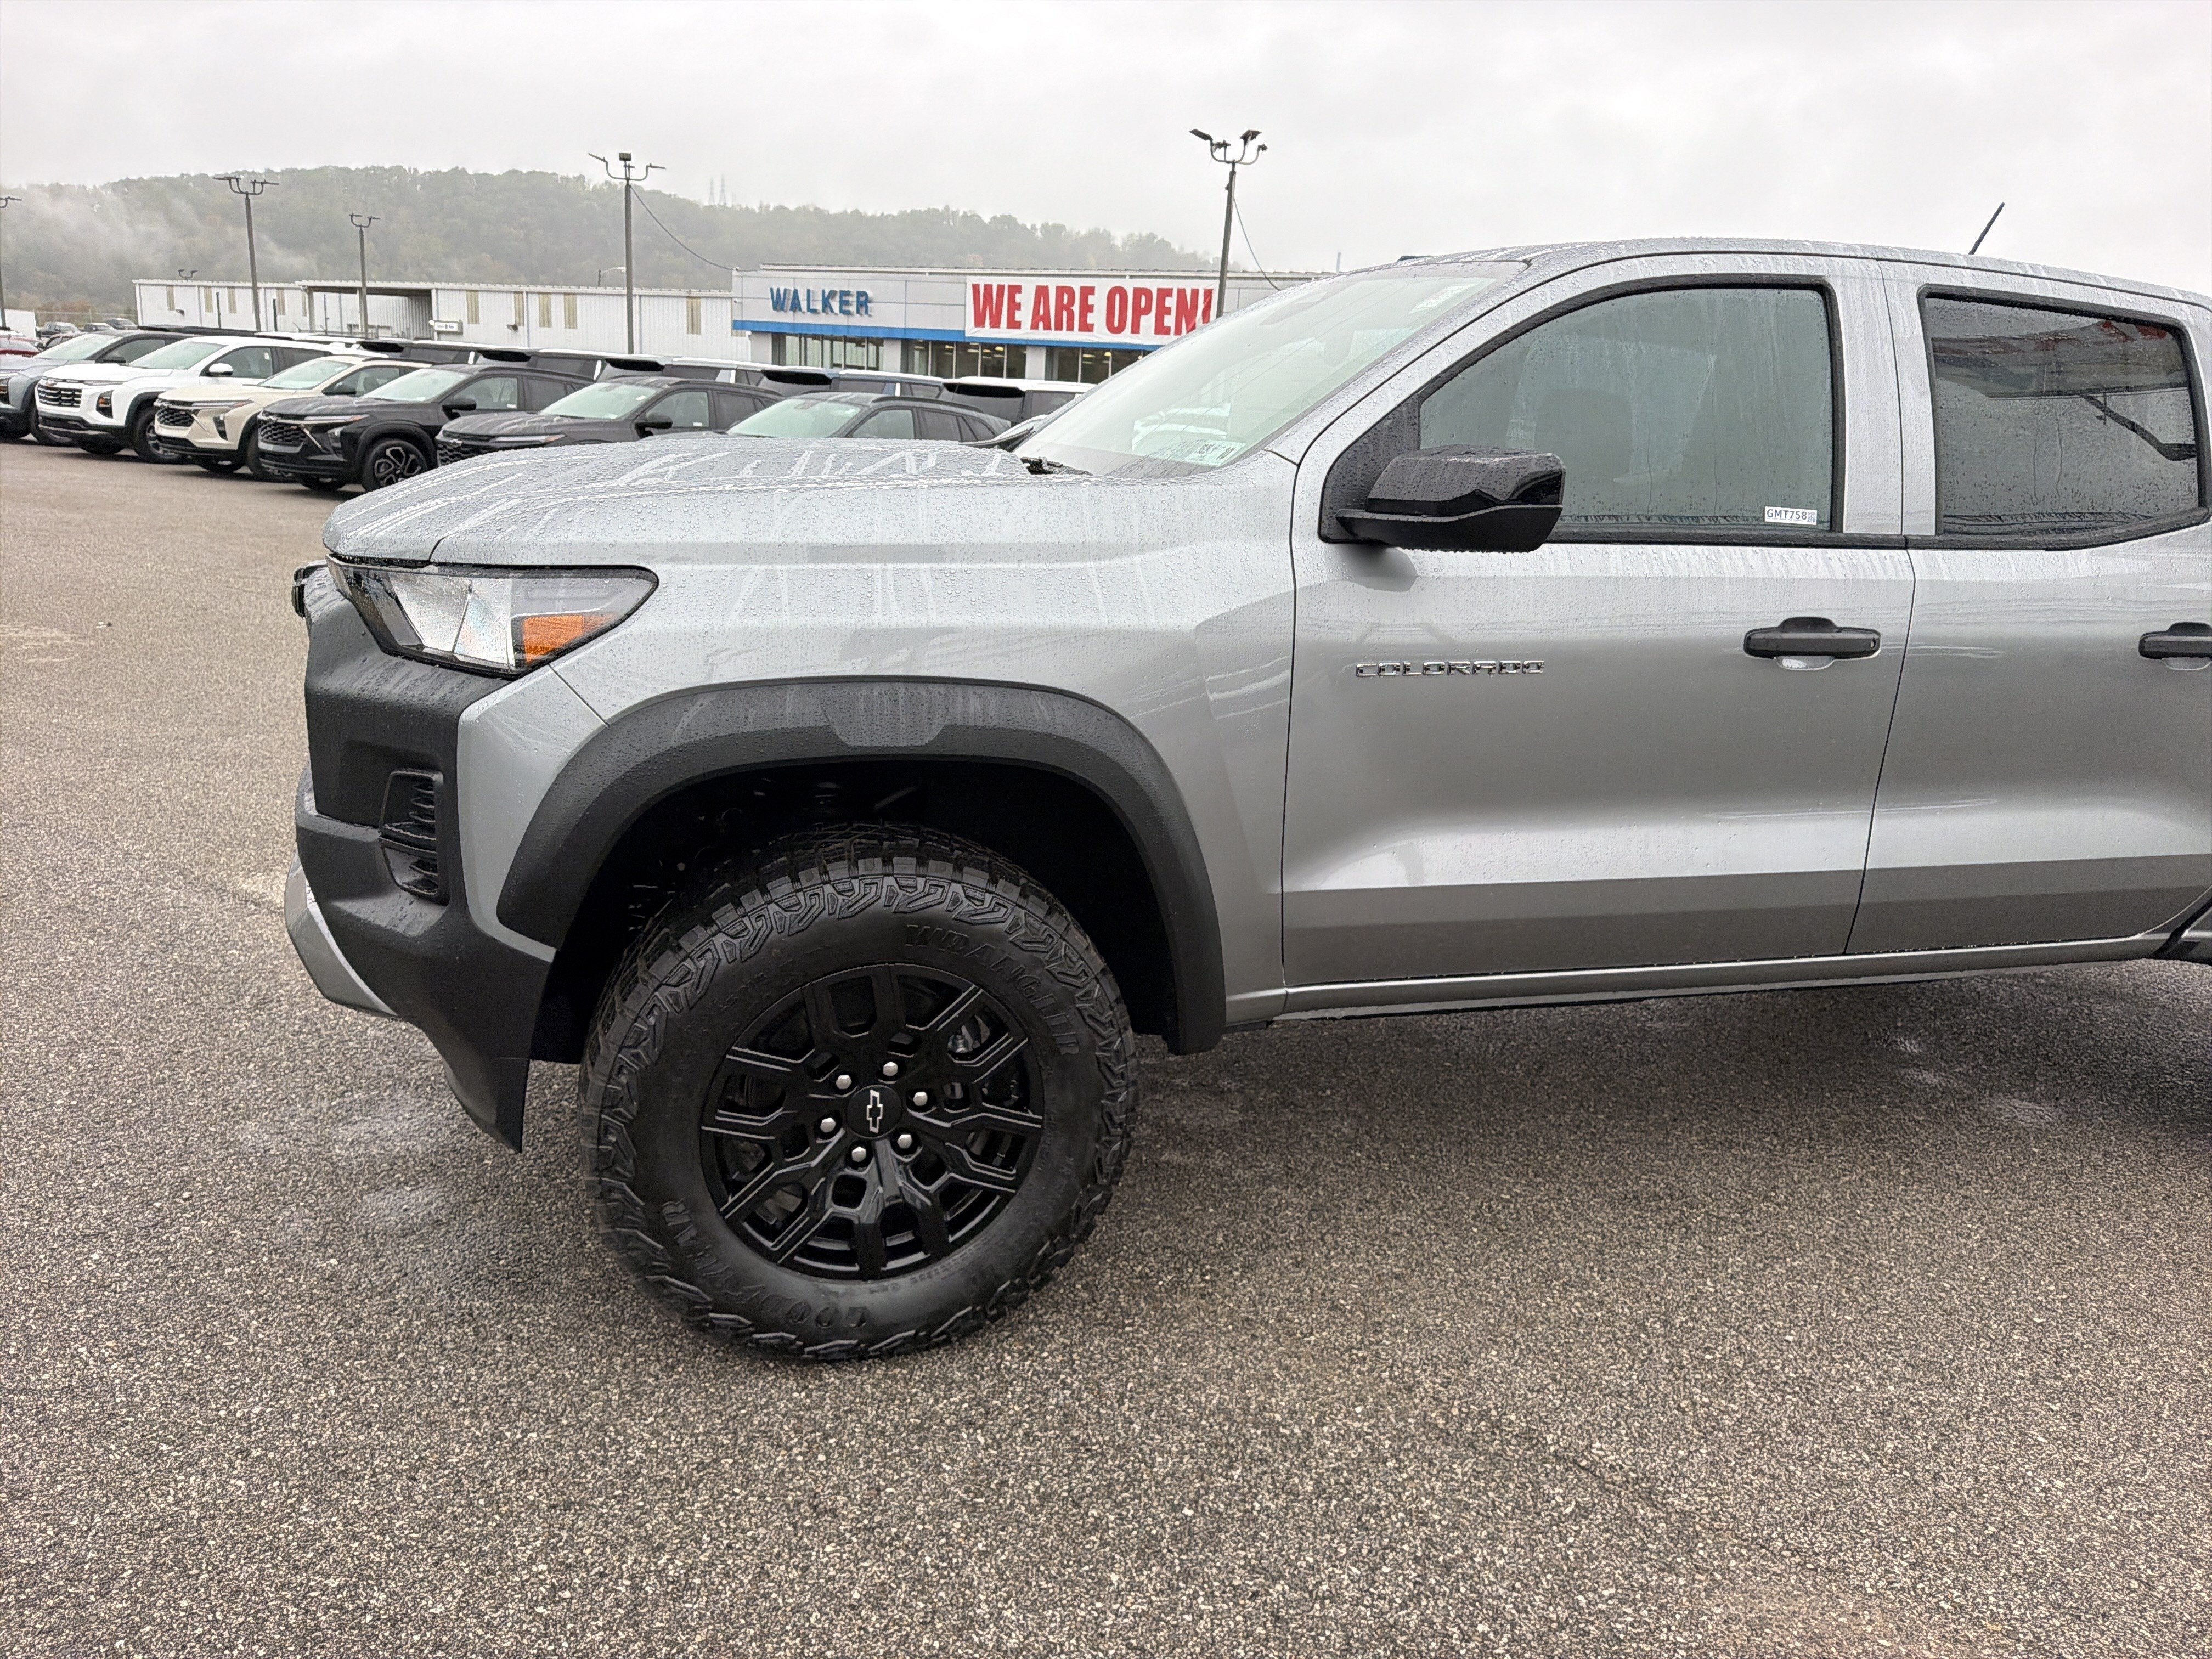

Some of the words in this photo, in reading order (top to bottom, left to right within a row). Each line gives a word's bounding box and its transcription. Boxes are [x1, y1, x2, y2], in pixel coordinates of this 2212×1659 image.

[770, 287, 871, 317] WALKER
[972, 284, 1022, 329] WE
[1030, 285, 1096, 332] ARE
[1767, 509, 1807, 520] GMT758
[1356, 660, 1544, 677] COLORADO
[903, 923, 1080, 1056] WRANGLER
[662, 1198, 871, 1329] GOODYEAR
